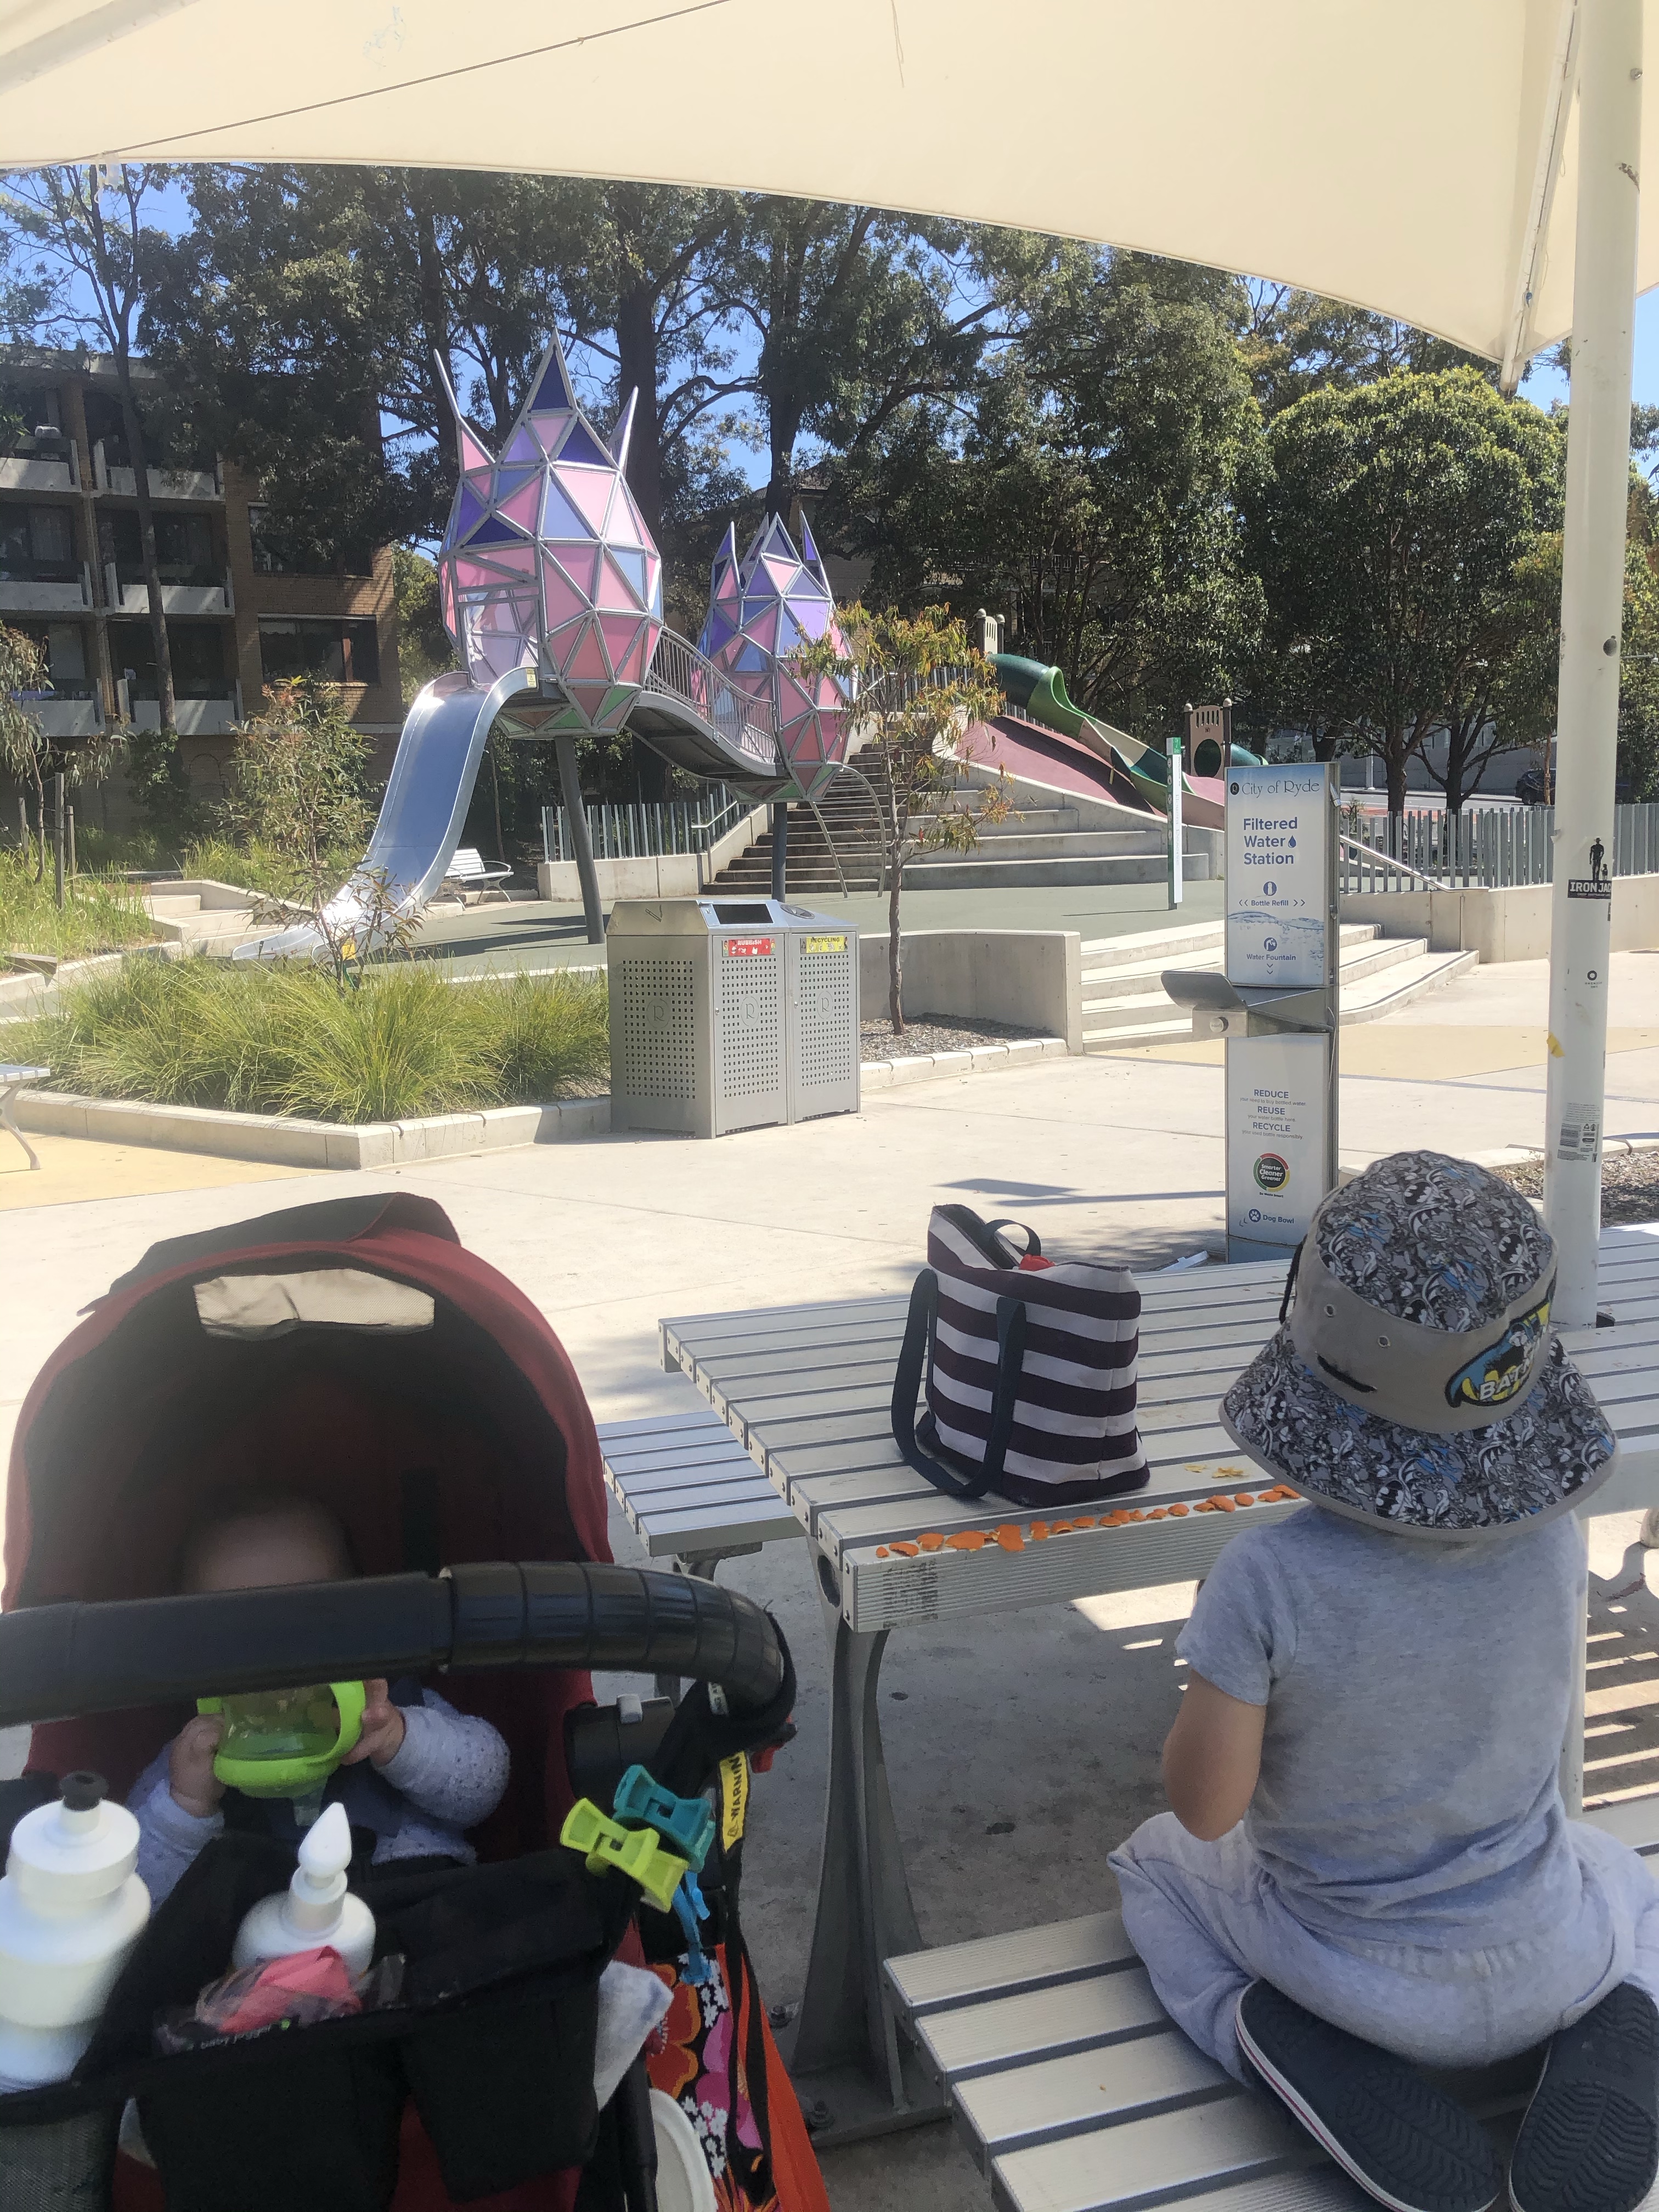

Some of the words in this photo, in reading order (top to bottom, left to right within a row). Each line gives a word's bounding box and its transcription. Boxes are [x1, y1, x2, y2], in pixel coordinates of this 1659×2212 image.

[1242, 782, 1263, 799] City
[1267, 780, 1281, 794] of
[1283, 778, 1320, 799] Ryde
[1243, 816, 1298, 831] Filtered
[1244, 836, 1286, 848] Water
[1244, 853, 1294, 865] Station
[1570, 882, 1598, 893] IRON
[1254, 1089, 1289, 1098] REDUCE
[1257, 1106, 1285, 1115] REUSE
[1252, 1122, 1291, 1132] RECYCLE
[1259, 1169, 1283, 1177] Cleaner
[1263, 1215, 1276, 1224] Dog
[1278, 1216, 1294, 1224] Bowl
